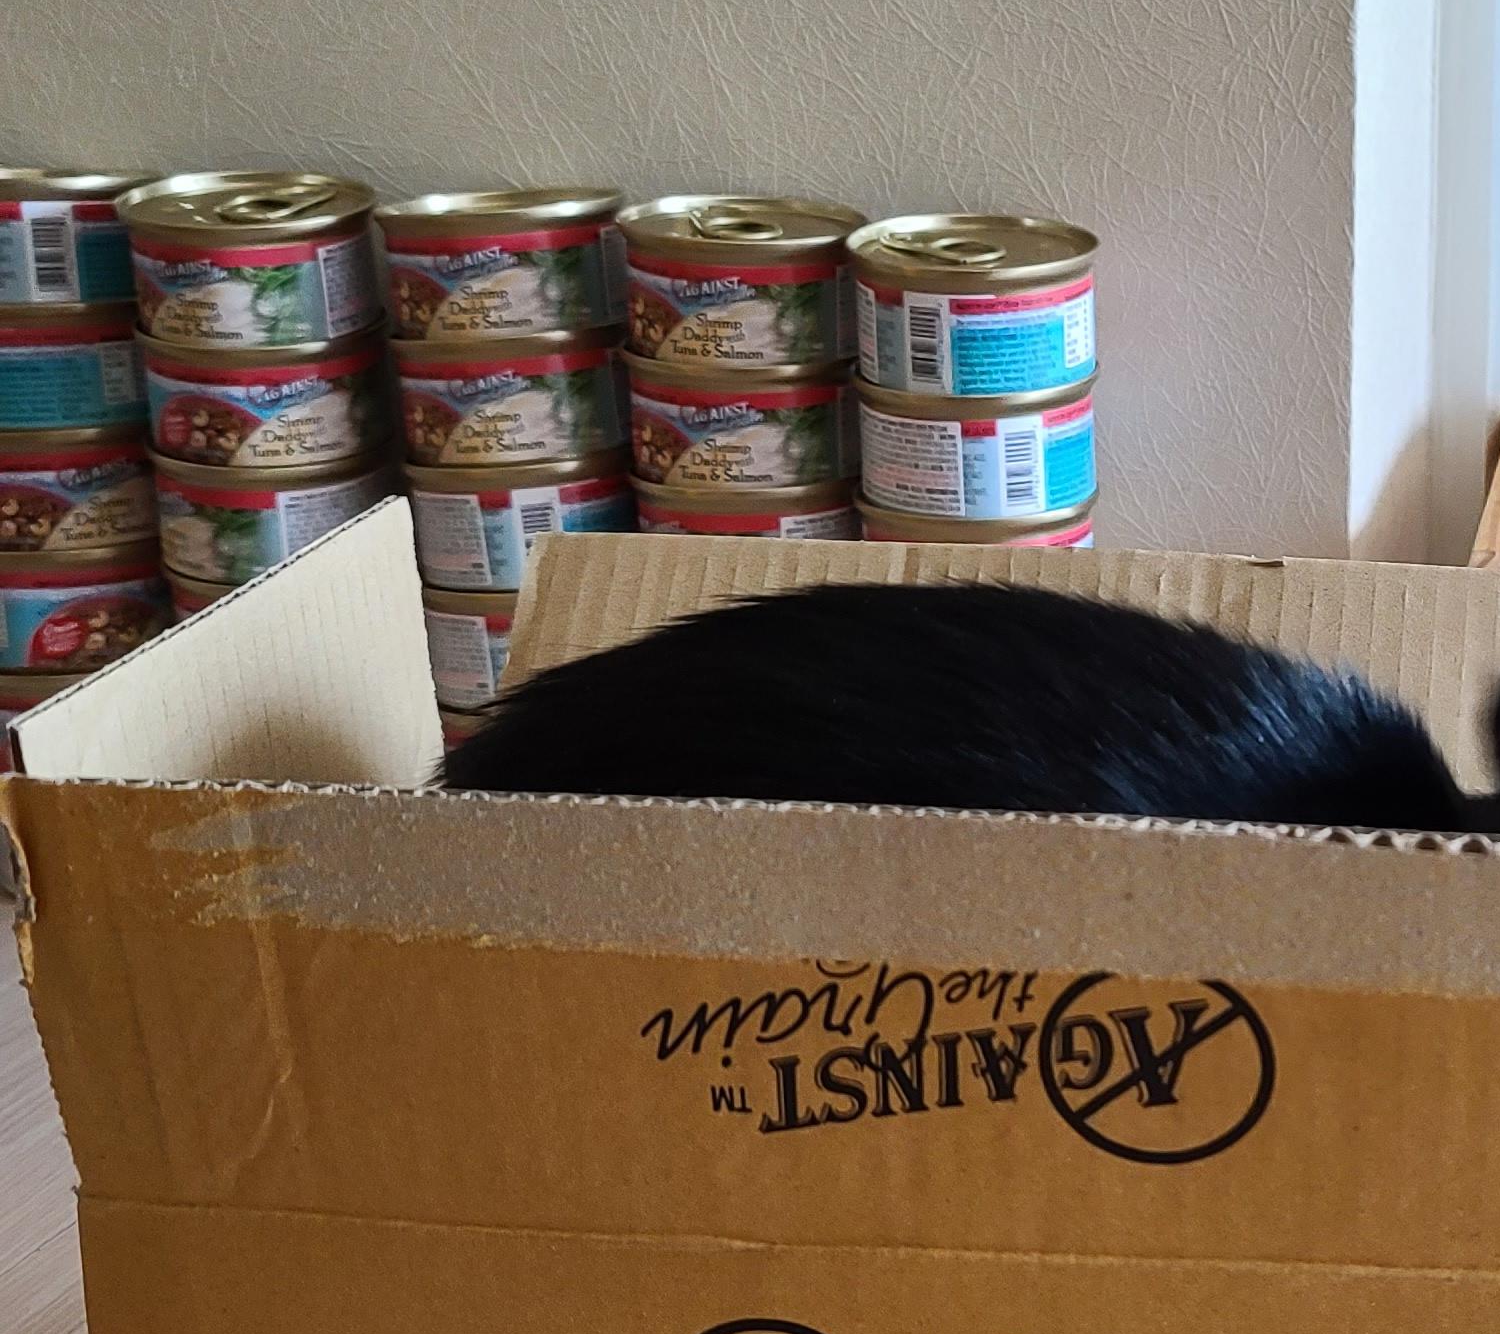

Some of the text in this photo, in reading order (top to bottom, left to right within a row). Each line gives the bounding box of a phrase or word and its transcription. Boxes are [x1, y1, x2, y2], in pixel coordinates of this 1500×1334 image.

[641, 962, 1037, 1068] the Grain
[759, 998, 1209, 1134] AGAINST
